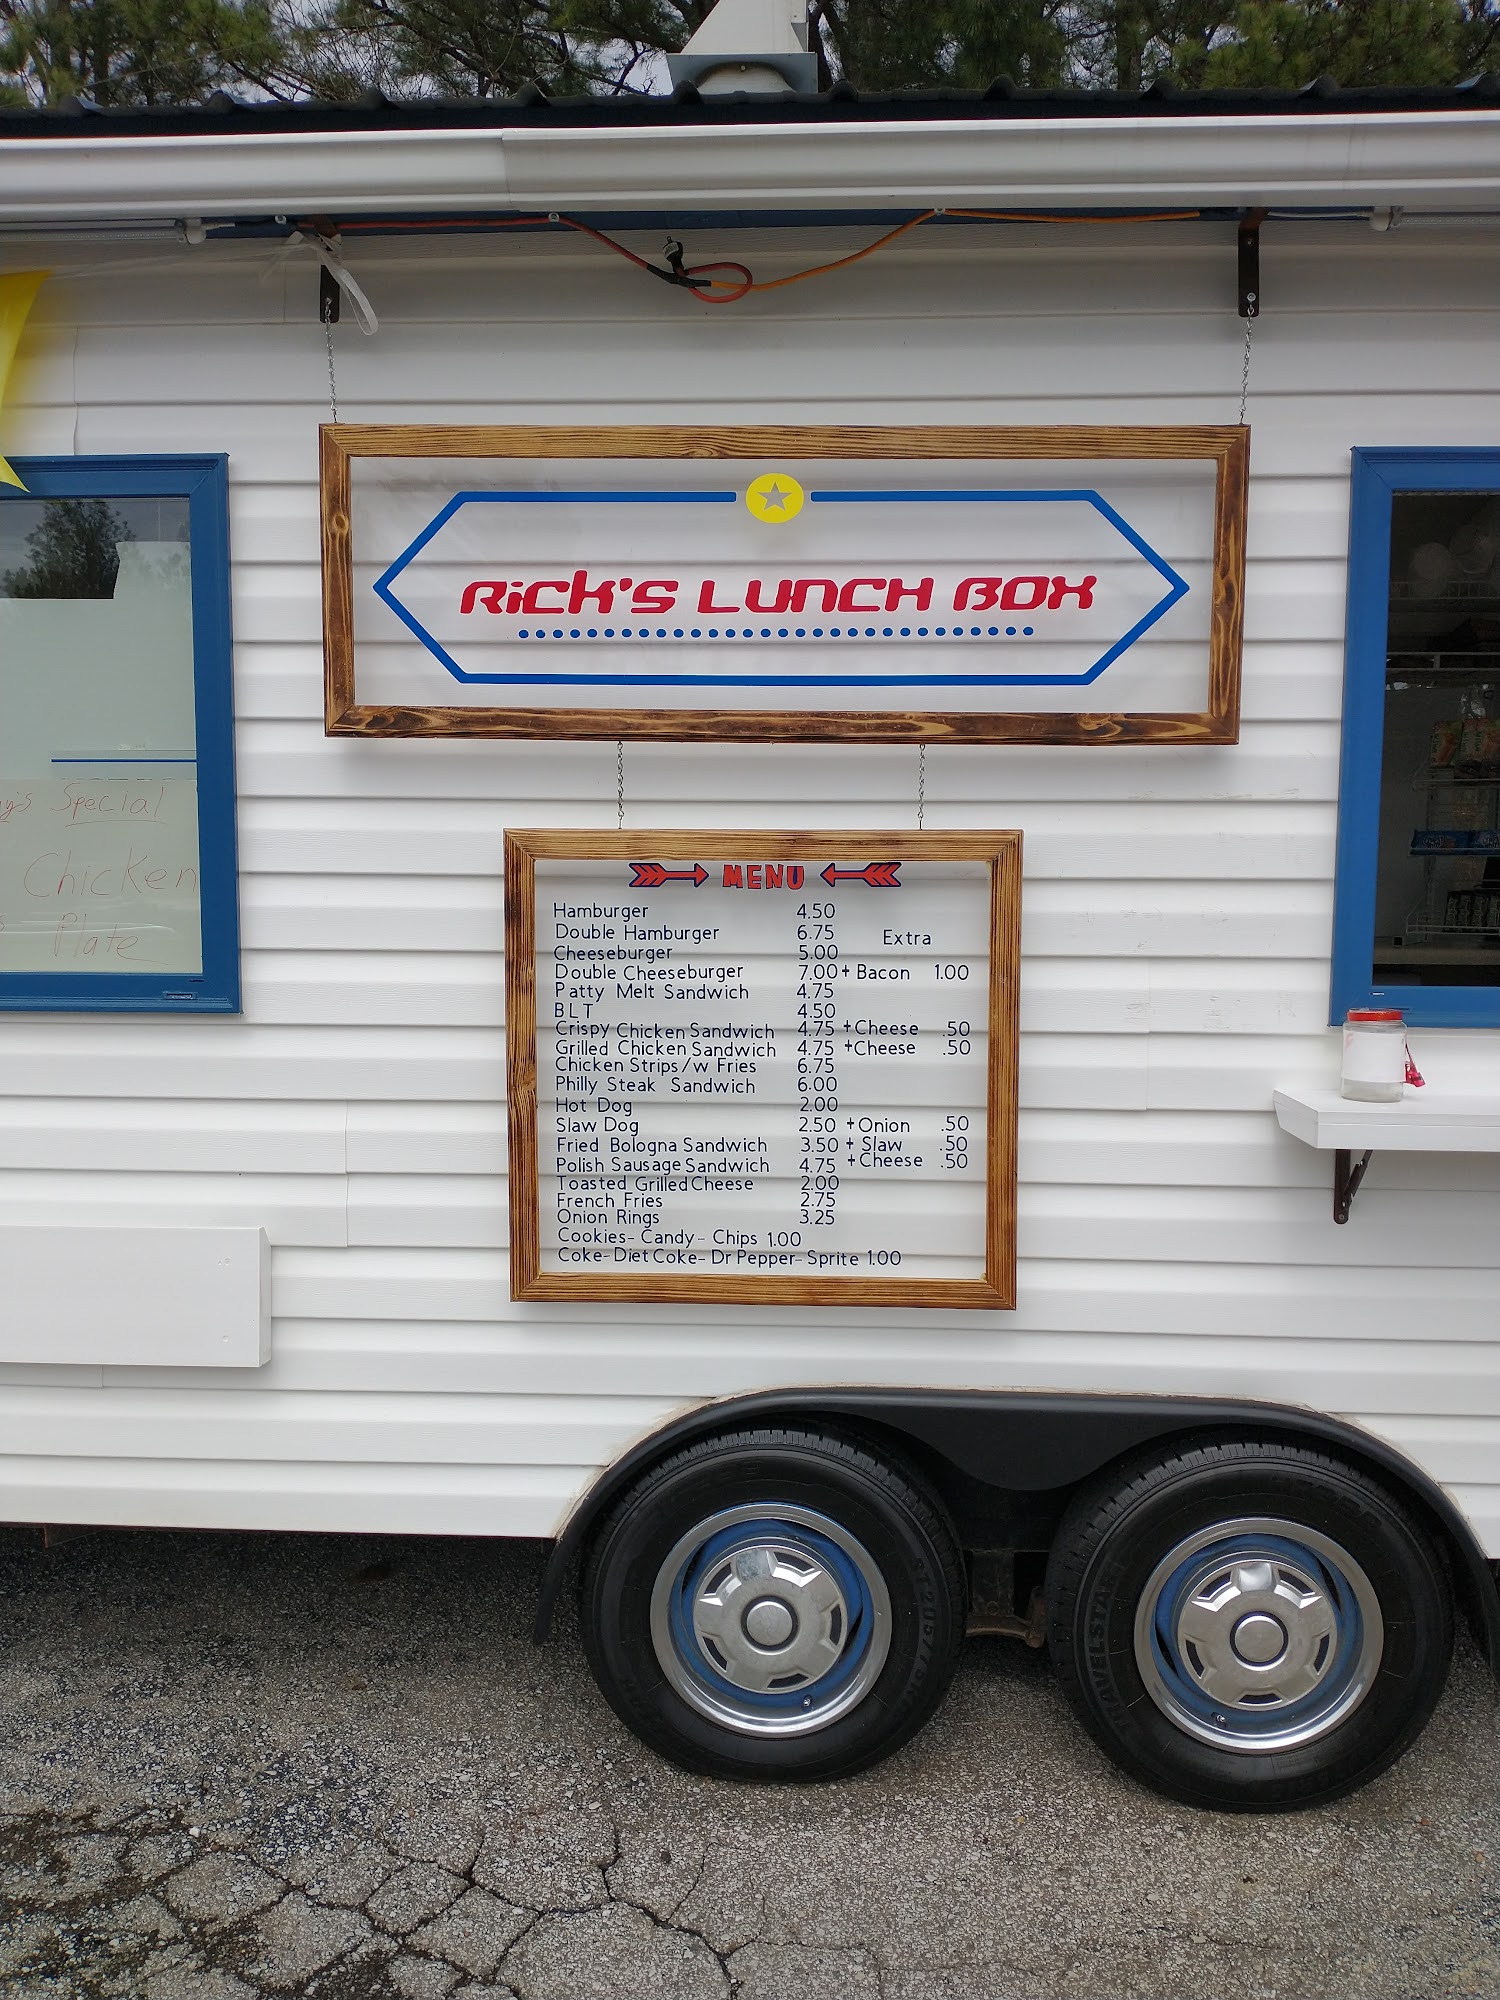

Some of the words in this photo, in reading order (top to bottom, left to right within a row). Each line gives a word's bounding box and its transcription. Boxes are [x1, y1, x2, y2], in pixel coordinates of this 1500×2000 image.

[697, 577, 934, 615] LUNCH
[952, 575, 1097, 612] BOX
[50, 782, 164, 820] Special
[722, 864, 804, 890] MENU
[554, 903, 648, 922] Hamburger
[797, 903, 835, 919] 4.50
[556, 923, 615, 939] Double
[625, 925, 719, 944] Hamburger
[798, 925, 834, 940] 6.75
[884, 929, 931, 945] Extra
[554, 945, 673, 964] Cheeseburger
[799, 944, 839, 960] 5.00
[556, 964, 616, 979] Double
[624, 964, 743, 984] Cheeseburger
[799, 964, 838, 980] 7.00
[857, 964, 909, 980] Bacon
[935, 964, 969, 980] 1.00
[556, 982, 604, 1002] Patty
[617, 983, 654, 998] Melt
[665, 984, 748, 999] Sandwich
[797, 983, 833, 999] 4.75
[797, 1003, 835, 1018] 4.50
[556, 1020, 610, 1039] Crispy
[617, 1023, 685, 1039] Chicken
[690, 1022, 775, 1039] Sandwich
[797, 1021, 834, 1036] 4.75
[942, 1021, 970, 1037] .50
[556, 1040, 608, 1057] Grilled
[618, 1040, 686, 1055] Chicken
[692, 1041, 776, 1057] Sandwich
[797, 1040, 834, 1056] 4.75
[943, 1040, 970, 1055] .50
[556, 1056, 623, 1073] Chicken
[718, 1058, 756, 1073] Fries
[798, 1058, 834, 1073] 6.75
[556, 1076, 598, 1095] Philly
[608, 1077, 656, 1092] Steak
[671, 1077, 755, 1093] Sandwich
[798, 1077, 837, 1092] 6.00
[555, 1097, 587, 1112] Hot
[598, 1097, 632, 1117] Dog
[799, 1097, 838, 1112] 2.00
[557, 1117, 597, 1132] Slaw
[605, 1117, 638, 1136] Dog
[799, 1117, 835, 1132] 2.50
[941, 1116, 969, 1131] .50
[558, 1137, 598, 1152] Fried
[611, 1137, 677, 1156] Bologna
[684, 1137, 767, 1152] Sandwich
[801, 1137, 838, 1152] 3.50
[862, 1136, 902, 1152] Slaw
[940, 1135, 967, 1151] .50
[557, 1157, 604, 1172] Polish
[611, 1157, 681, 1176] Sausage
[686, 1157, 769, 1173] Sandwich
[799, 1158, 835, 1173] 4.75
[941, 1153, 967, 1169] .50
[557, 1175, 626, 1190] Toasted
[635, 1175, 687, 1191] Grilled
[691, 1176, 754, 1191] Cheese
[800, 1175, 839, 1190] 2.00
[558, 1193, 614, 1207] French
[625, 1192, 662, 1207] Fries
[801, 1192, 835, 1207] 2.75
[557, 1209, 607, 1225] Onion
[617, 1209, 659, 1228] Rings
[800, 1209, 834, 1225] 3.25
[713, 1229, 757, 1248] Chips
[768, 1232, 801, 1247] 1.00
[712, 1249, 732, 1264] Dr
[807, 1250, 859, 1268] Sprite
[867, 1250, 901, 1265] 1.00
